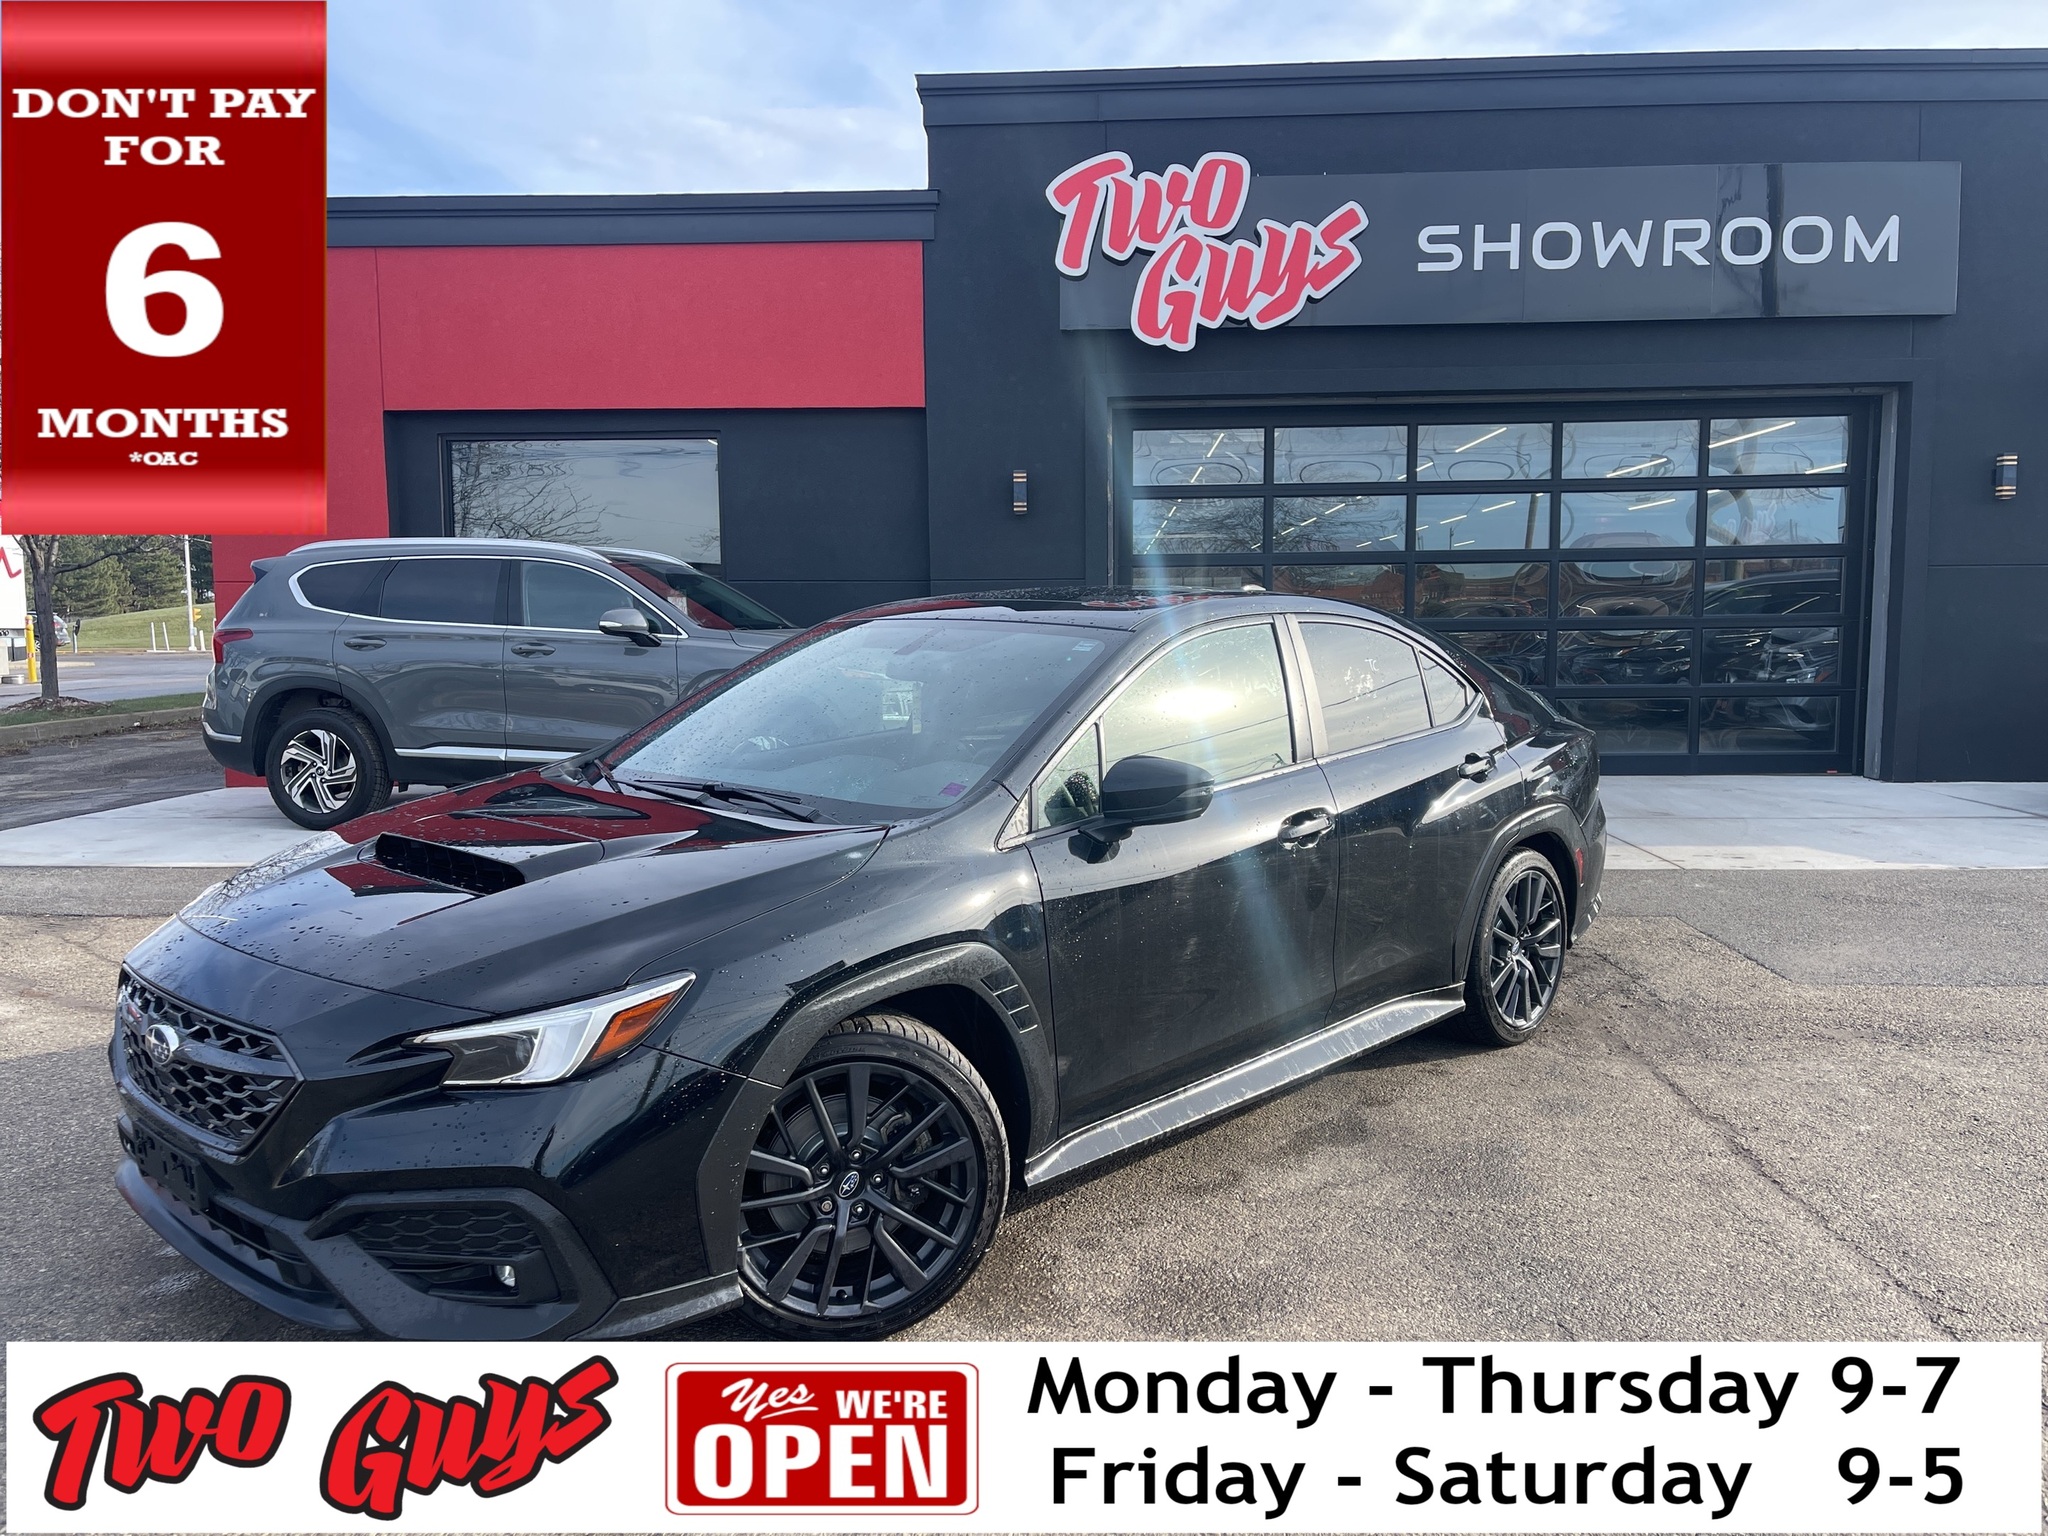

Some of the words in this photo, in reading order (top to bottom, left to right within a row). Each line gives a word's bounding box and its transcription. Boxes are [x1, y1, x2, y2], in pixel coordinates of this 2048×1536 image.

[1048, 153, 1249, 274] Two
[1417, 214, 1900, 272] SHOWROOM
[1133, 201, 1367, 350] Guys
